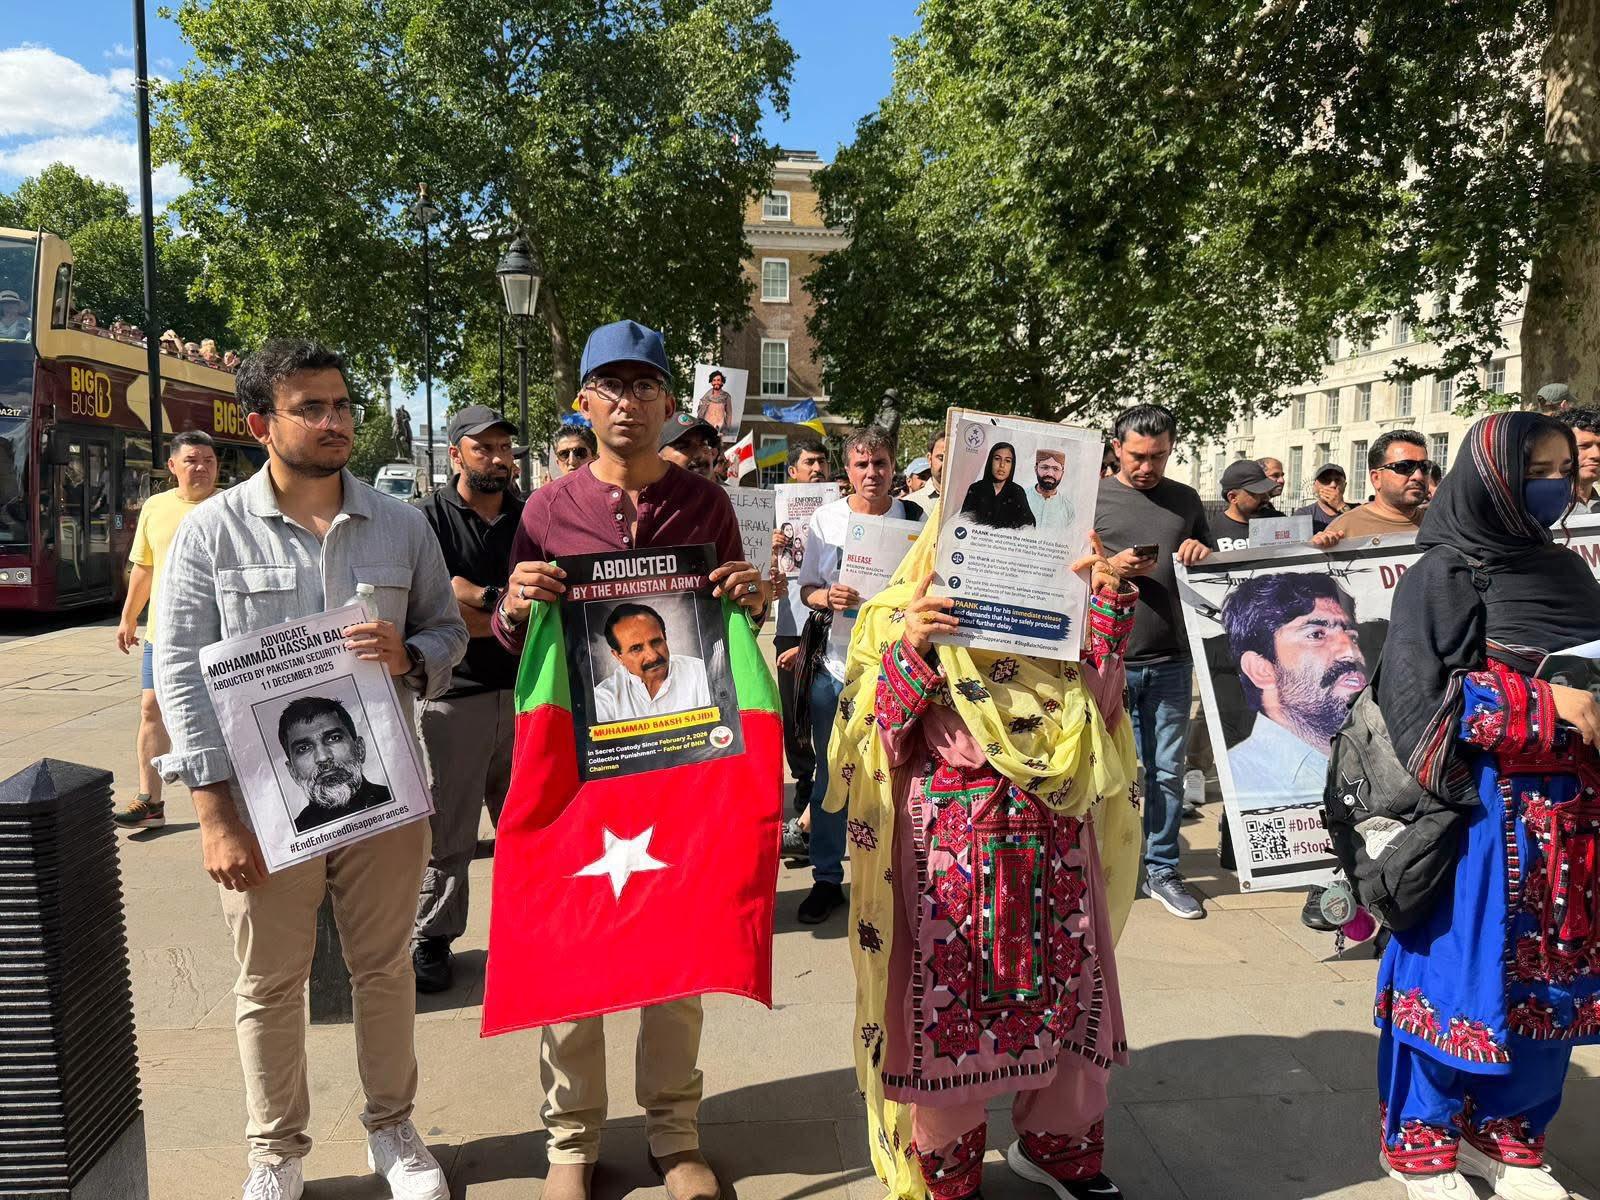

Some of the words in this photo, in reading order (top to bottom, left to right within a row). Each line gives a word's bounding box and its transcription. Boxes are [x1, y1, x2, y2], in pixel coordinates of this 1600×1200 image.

[71, 367, 94, 394] BIG
[72, 393, 94, 416] BUS
[592, 554, 677, 580] ABDUCTED
[848, 554, 872, 564] RELEASE
[573, 587, 588, 599] BY
[591, 585, 612, 597] THE
[616, 579, 667, 595] PAKISTAN
[670, 576, 701, 589] ARMY
[956, 602, 978, 610] PAANK
[1012, 610, 1041, 619] immediate
[1042, 614, 1061, 622] release
[966, 611, 990, 620] demands
[1019, 618, 1034, 627] safely
[1034, 621, 1060, 631] produced
[260, 625, 309, 649] ADVOCATE
[976, 620, 996, 628] further
[996, 623, 1013, 632] delay.
[207, 647, 276, 678] MOHAMMAD
[278, 636, 323, 657] HASSAN
[213, 672, 254, 691] ABDUCTED
[254, 667, 265, 678] BY
[266, 657, 305, 675] PAKISTANI
[306, 646, 342, 662] SECURITY
[261, 680, 272, 691] 11
[273, 668, 313, 688] DECEMBER
[315, 661, 334, 676] 2025
[593, 724, 650, 737] MUHAMMAD
[653, 718, 682, 728] BAKSH
[684, 711, 713, 722] SAJIDI
[588, 756, 619, 764] Collective
[620, 750, 656, 760] Punishment
[663, 744, 682, 752] Father
[616, 744, 641, 753] Custody
[659, 736, 686, 745] February
[589, 764, 619, 772] Chairman
[290, 804, 409, 853] #EndEnforcedDisappearances
